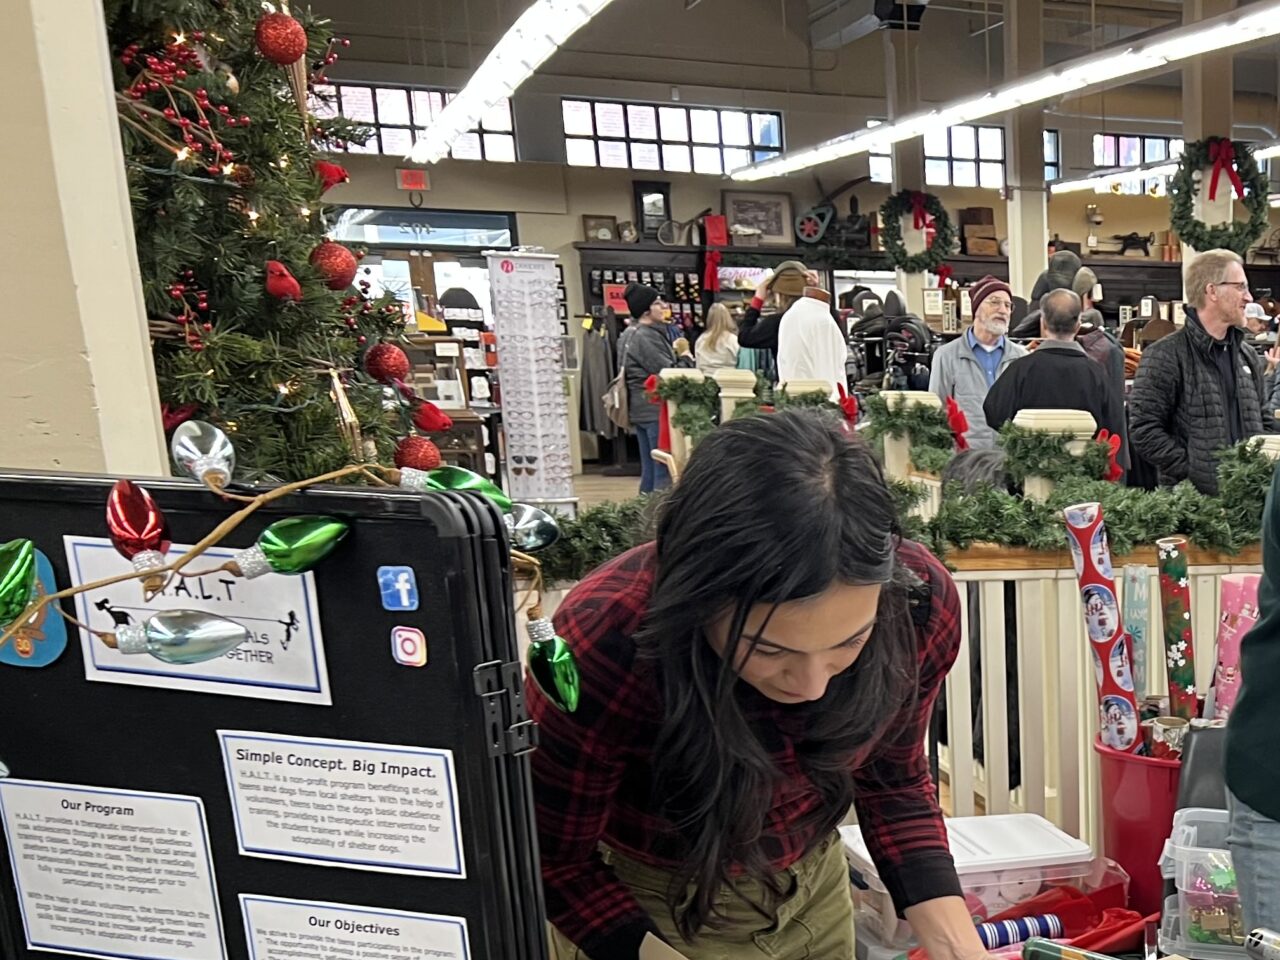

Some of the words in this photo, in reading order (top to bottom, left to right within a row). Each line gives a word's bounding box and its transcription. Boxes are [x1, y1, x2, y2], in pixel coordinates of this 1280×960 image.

[224, 648, 274, 664] GETHER
[236, 748, 282, 764] Simple
[286, 753, 346, 771] Concept.
[352, 759, 375, 775] Big
[380, 761, 435, 778] Impact.
[60, 798, 81, 810] Our
[84, 801, 134, 816] Program
[308, 915, 331, 927] Our
[334, 919, 399, 936] Objectives
